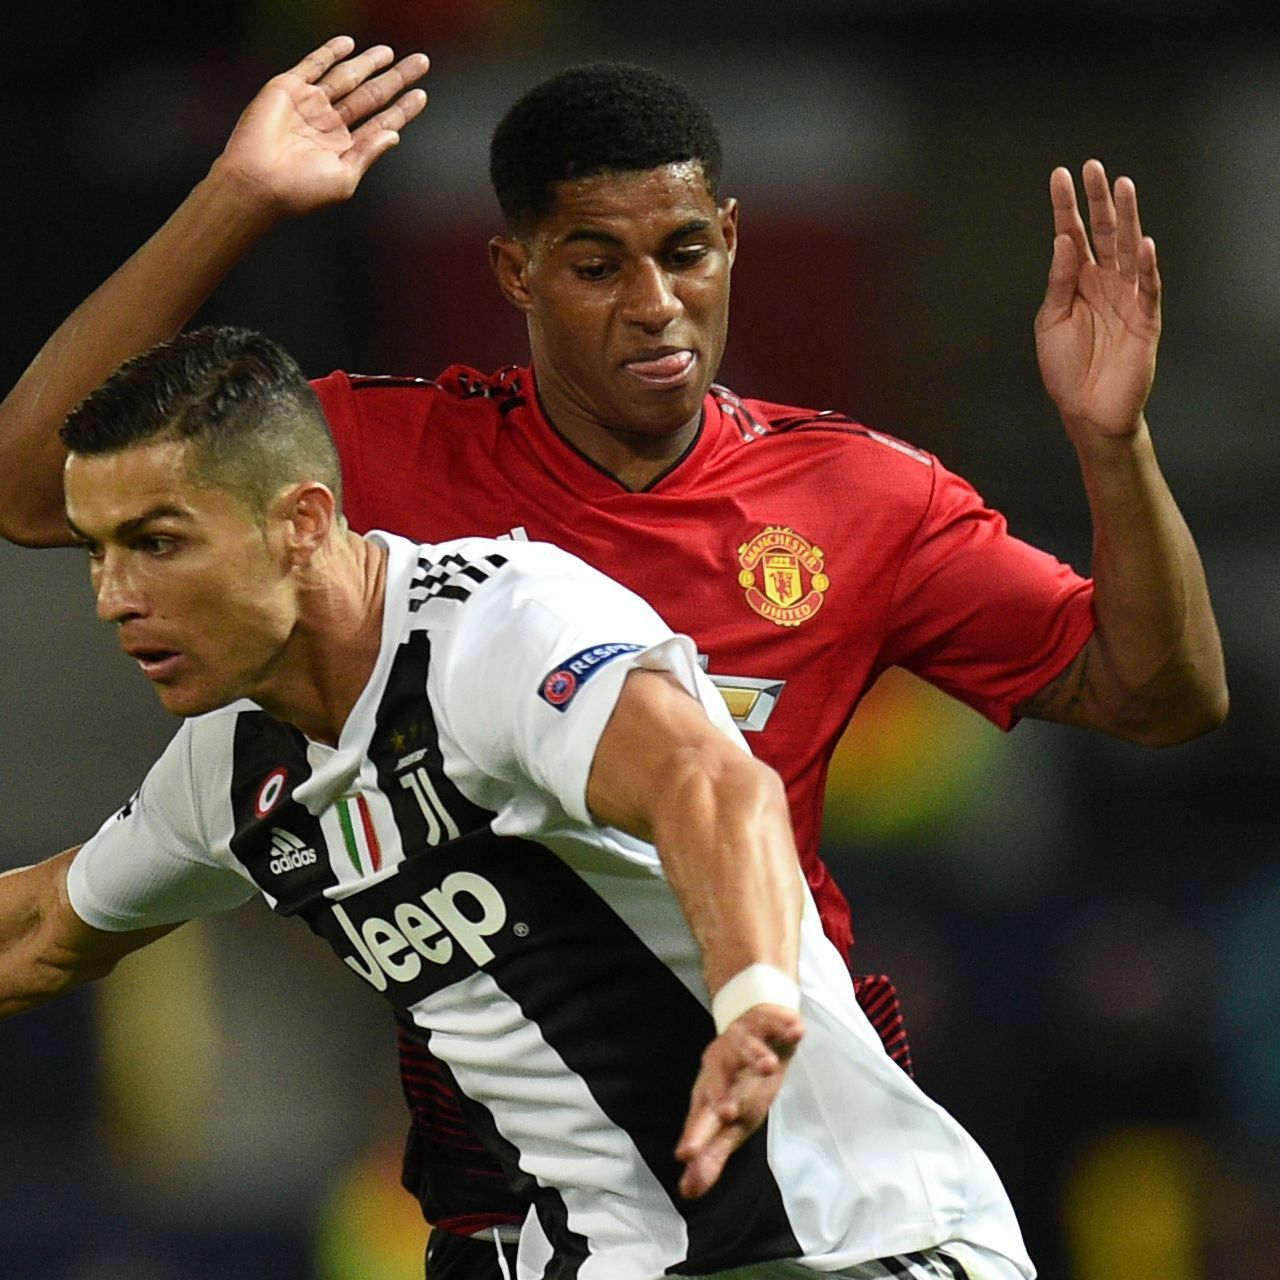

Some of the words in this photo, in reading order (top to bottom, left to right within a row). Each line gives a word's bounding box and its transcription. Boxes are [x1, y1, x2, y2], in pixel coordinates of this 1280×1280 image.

[744, 534, 818, 568] MANCHESTER
[760, 603, 812, 620] UNITED
[270, 848, 317, 875] adidas
[331, 871, 507, 992] Jeep
